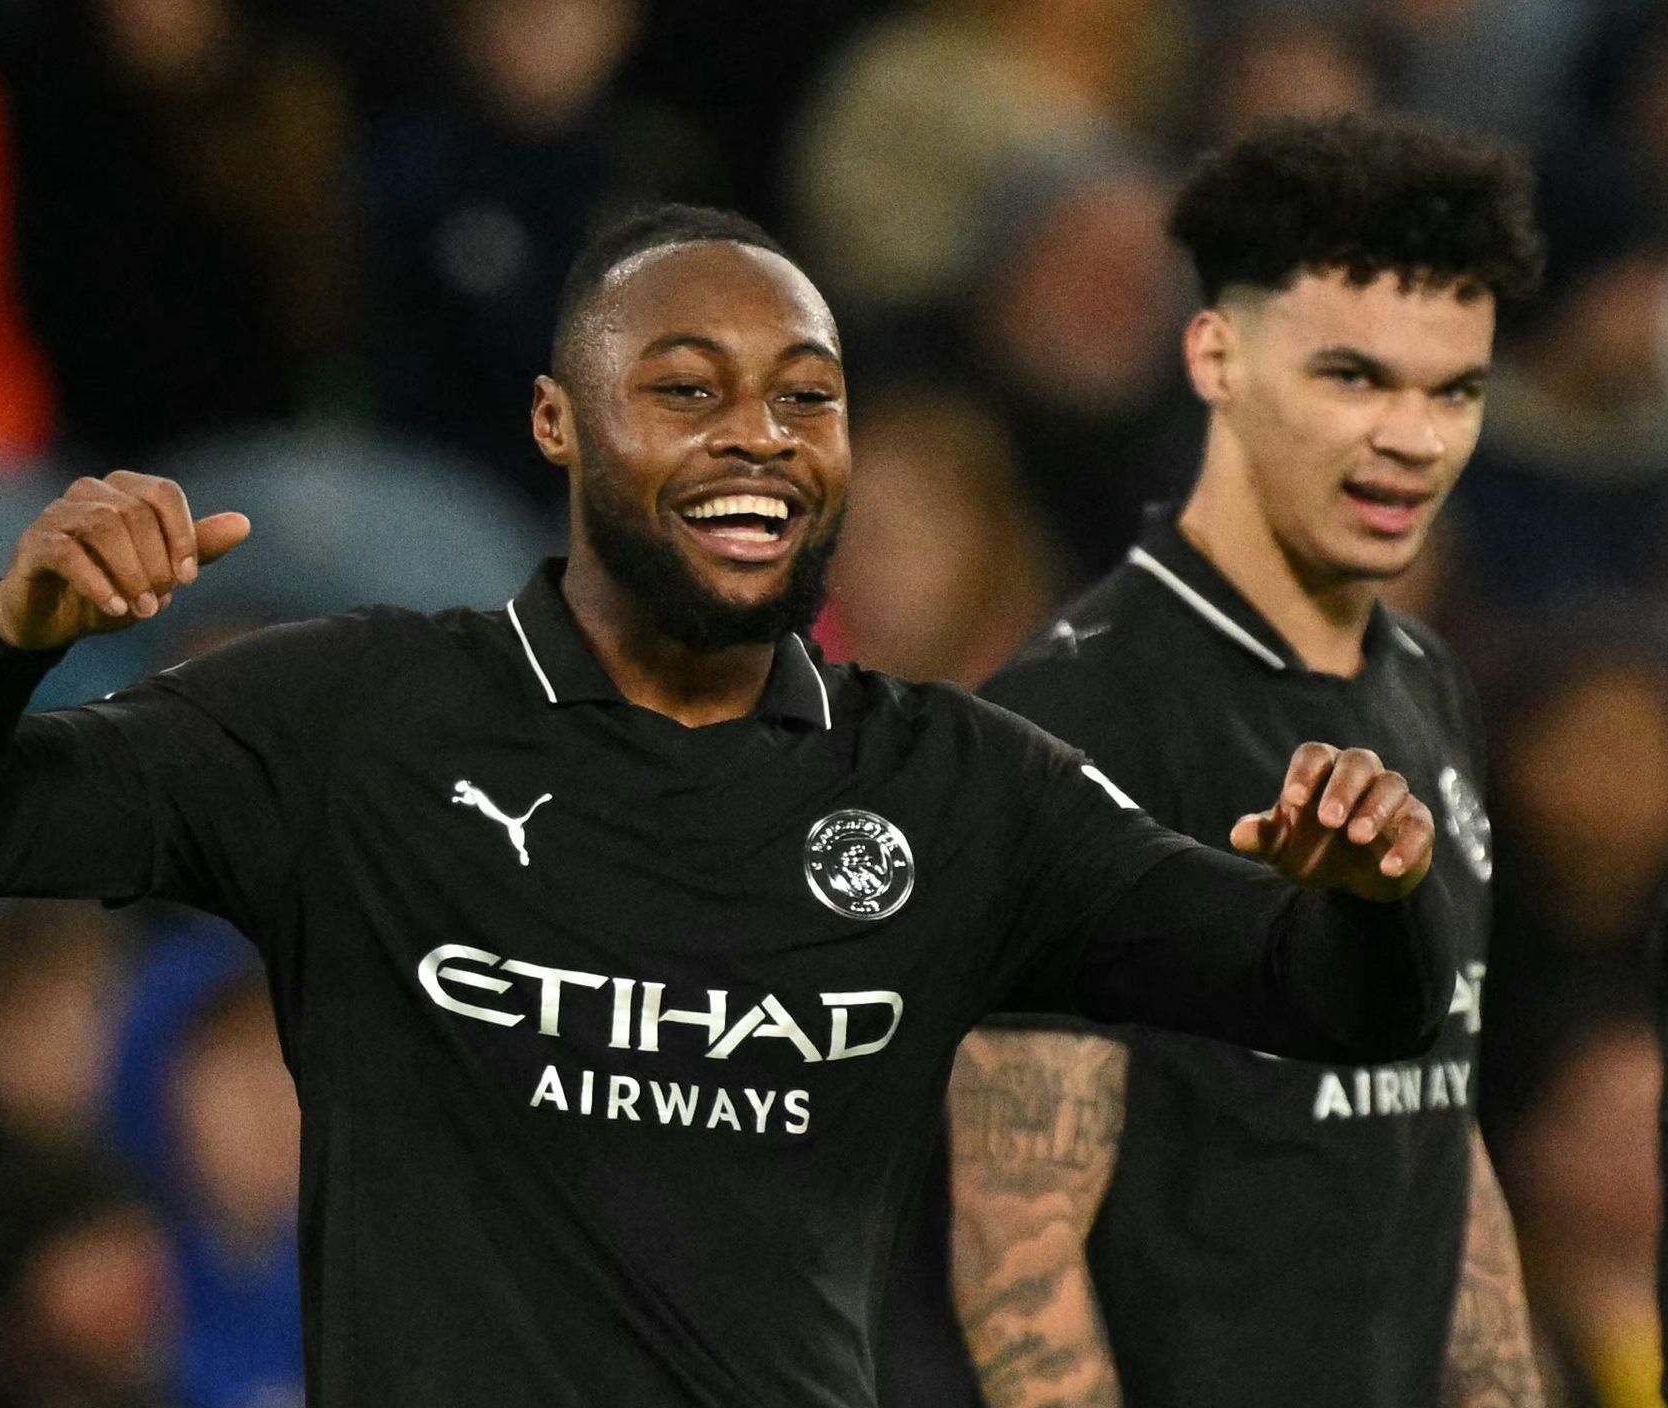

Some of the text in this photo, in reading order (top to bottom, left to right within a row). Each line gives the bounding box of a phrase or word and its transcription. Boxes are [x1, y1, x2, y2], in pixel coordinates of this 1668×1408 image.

[417, 943, 904, 1063] ETIHAD
[530, 1065, 810, 1135] AIRWAYS
[1314, 1062, 1471, 1121] AIRWAY
